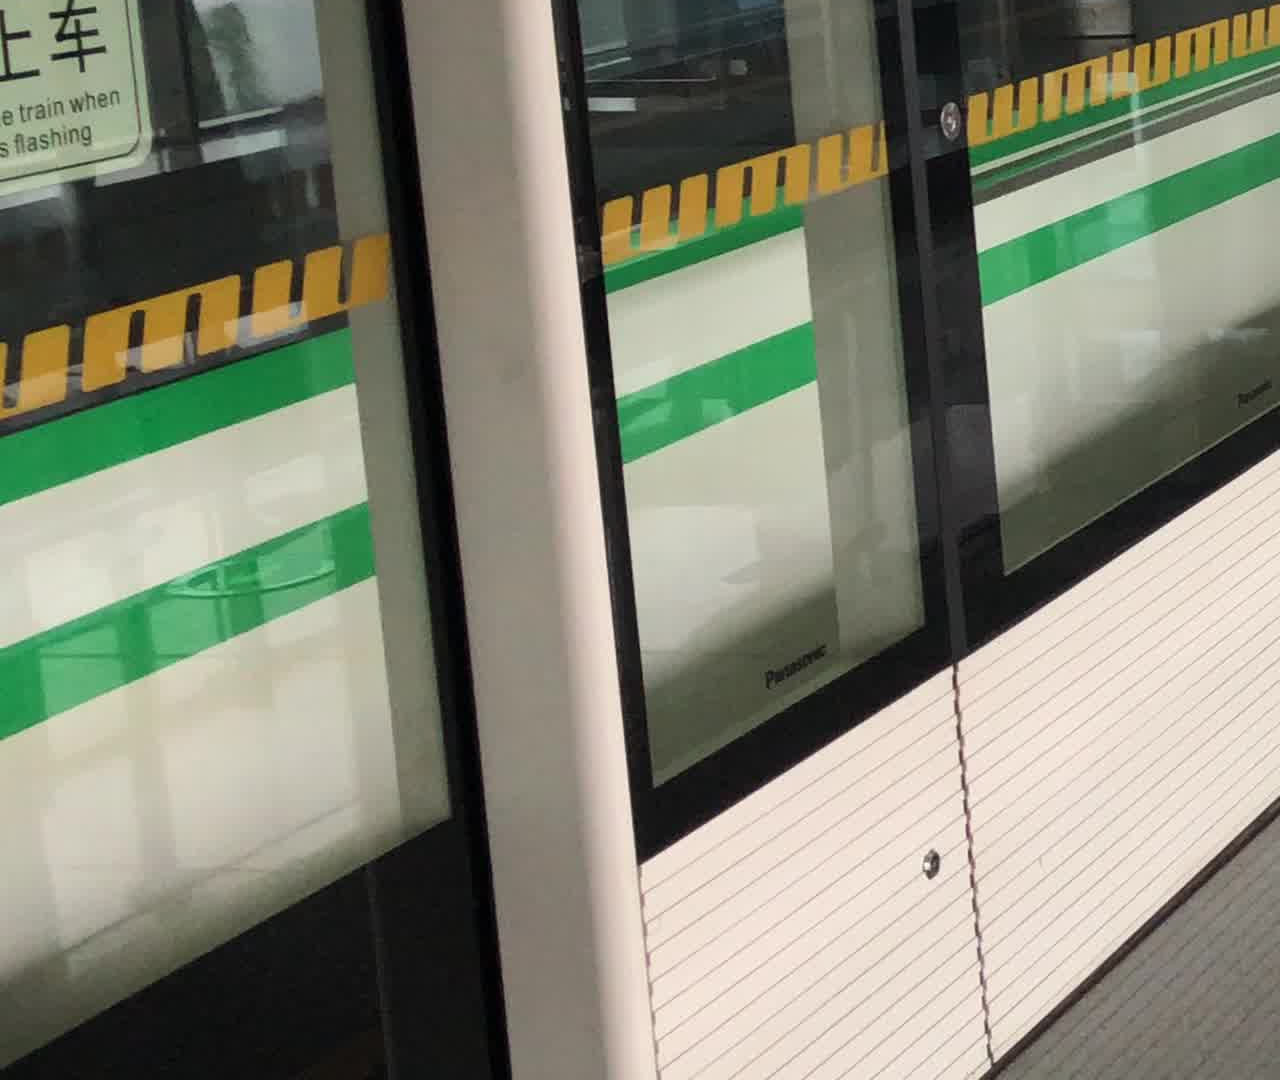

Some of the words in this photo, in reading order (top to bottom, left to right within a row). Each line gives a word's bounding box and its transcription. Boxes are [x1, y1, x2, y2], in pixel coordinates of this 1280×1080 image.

[19, 97, 65, 123] train
[69, 89, 121, 114] when
[14, 124, 92, 155] flashing
